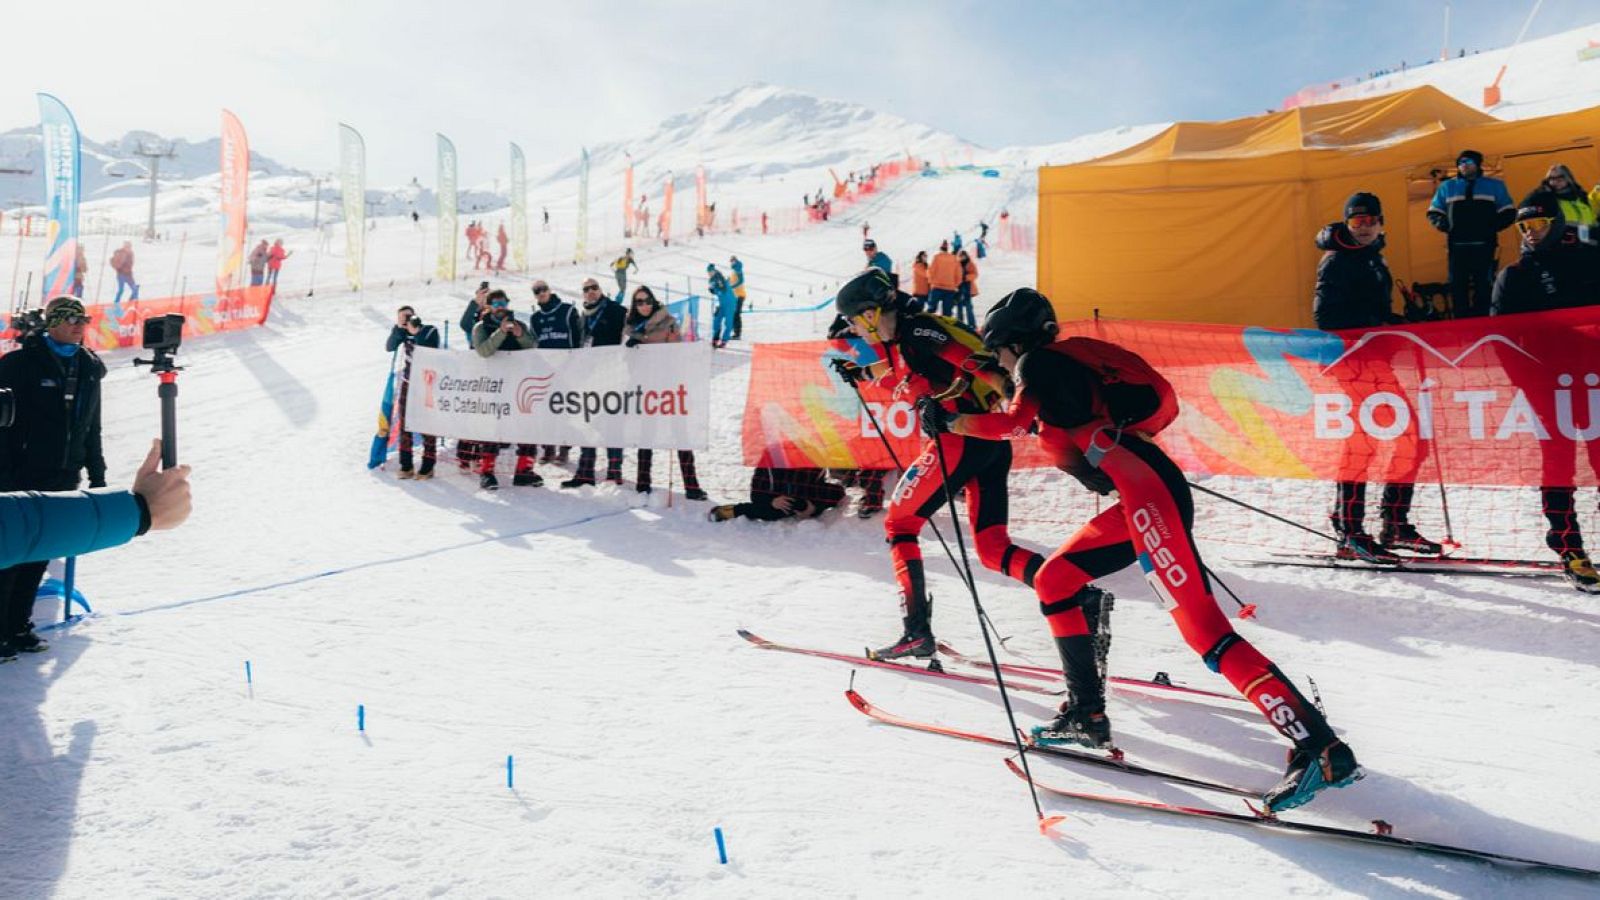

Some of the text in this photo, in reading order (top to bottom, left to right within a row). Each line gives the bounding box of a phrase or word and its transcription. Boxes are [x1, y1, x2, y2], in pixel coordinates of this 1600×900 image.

[439, 375, 504, 394] Generalitat
[548, 384, 688, 423] esportcat
[439, 396, 511, 420] de Catalunya
[861, 401, 926, 438] BO
[1314, 377, 1433, 441] BOÍ
[1259, 692, 1311, 742] ESP
